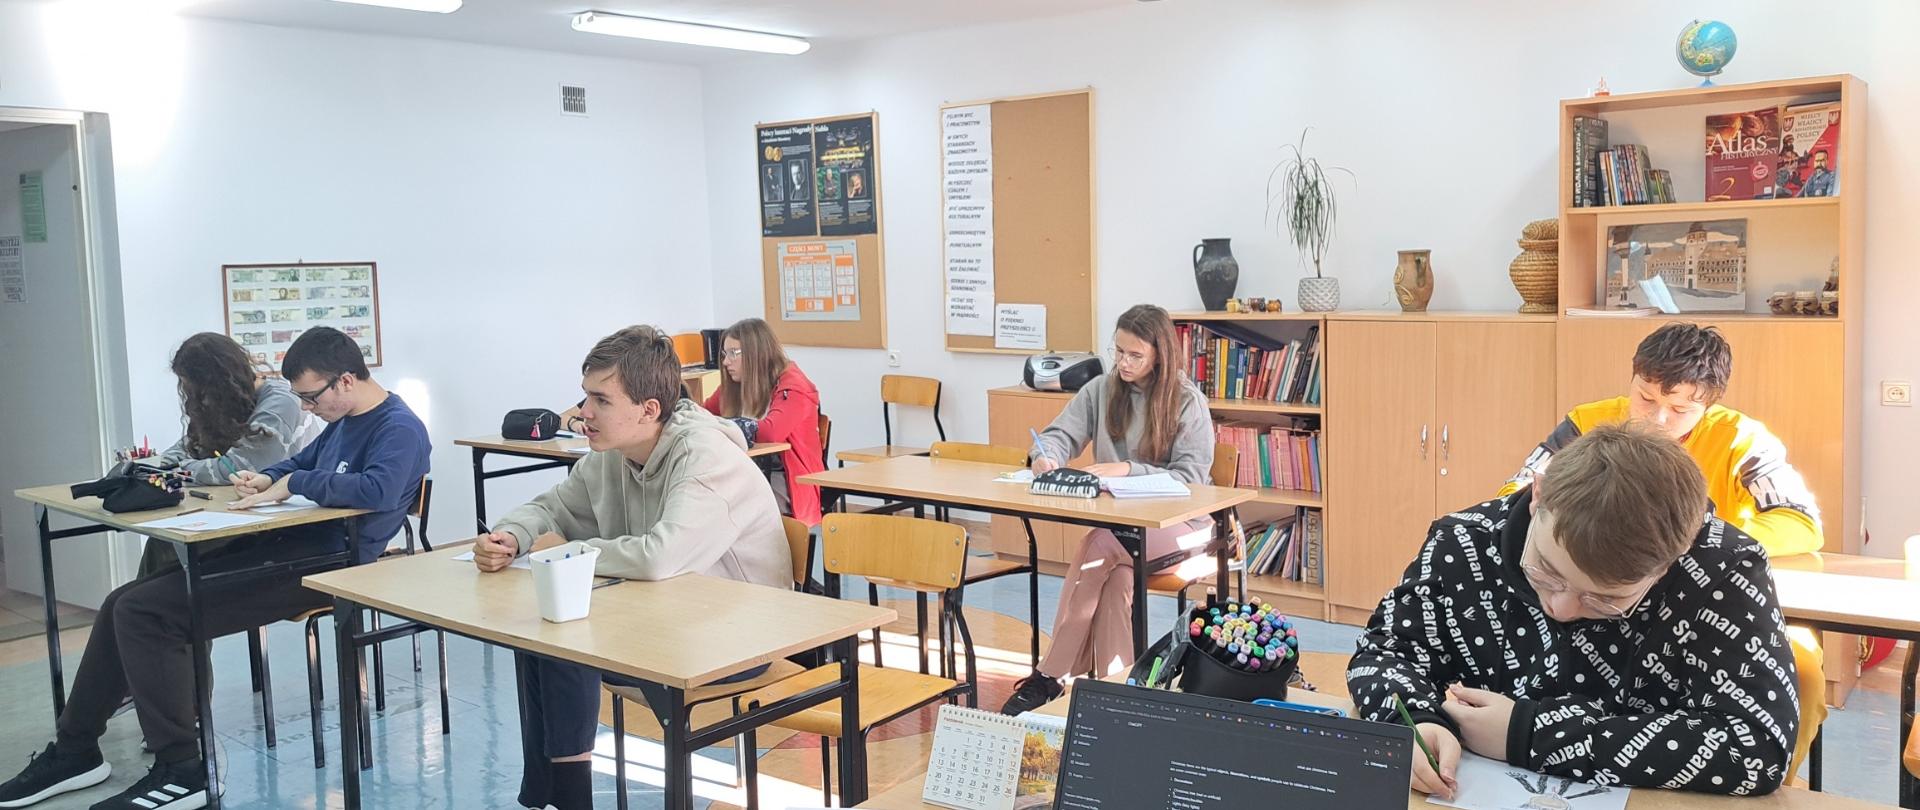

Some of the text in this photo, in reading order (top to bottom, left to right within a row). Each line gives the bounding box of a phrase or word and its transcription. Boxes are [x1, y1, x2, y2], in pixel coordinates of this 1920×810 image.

[1706, 129, 1767, 156] Atlas
[1720, 147, 1778, 160] HISTORYCZNY
[1708, 177, 1735, 201] 2
[1453, 524, 1484, 582] earman
[1710, 668, 1787, 749] Spearman
[1660, 727, 1728, 791] Spearma
[967, 792, 974, 800] 30
